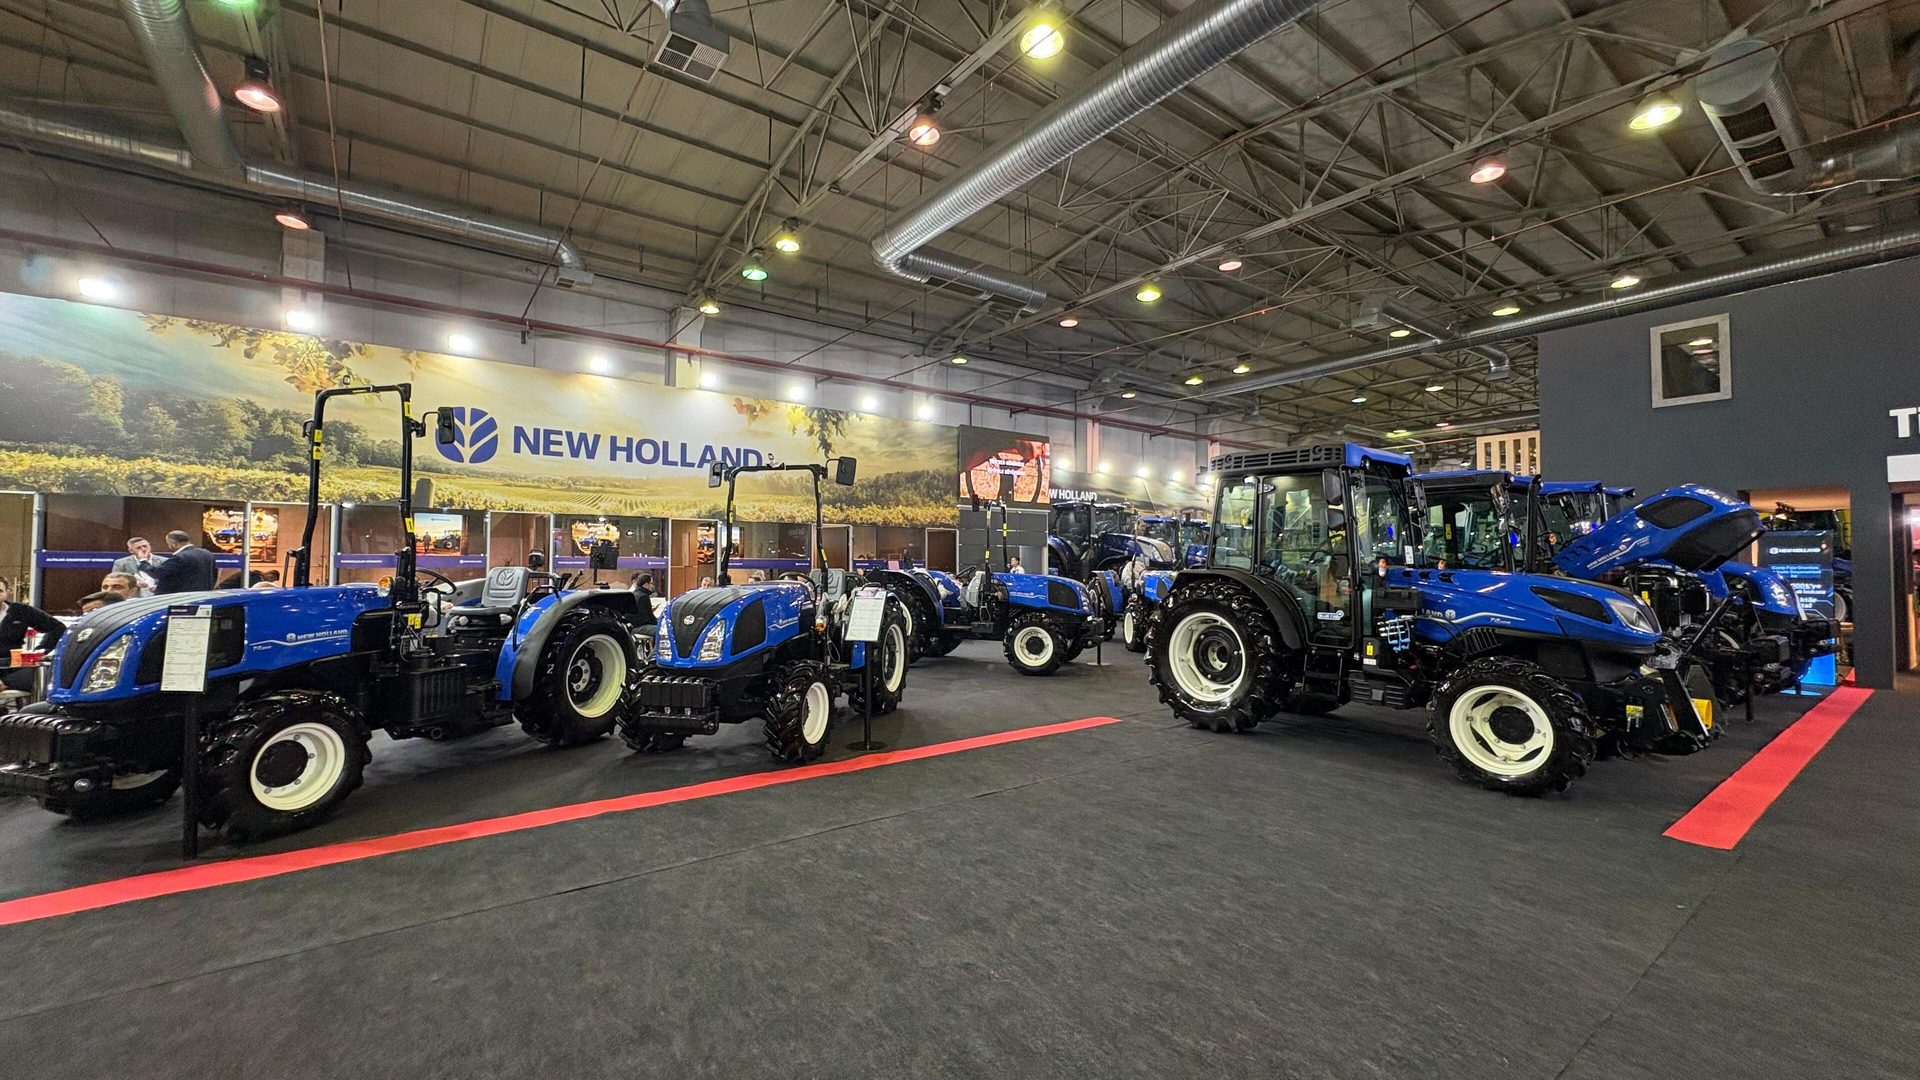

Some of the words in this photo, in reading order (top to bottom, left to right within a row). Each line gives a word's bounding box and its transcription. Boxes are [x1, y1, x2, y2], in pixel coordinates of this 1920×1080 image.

[1889, 407, 1920, 438] T
[513, 425, 601, 460] NEW
[609, 435, 763, 469] HOLLAND
[1059, 489, 1097, 501] HOLLAND
[316, 629, 348, 638] HOLLAND
